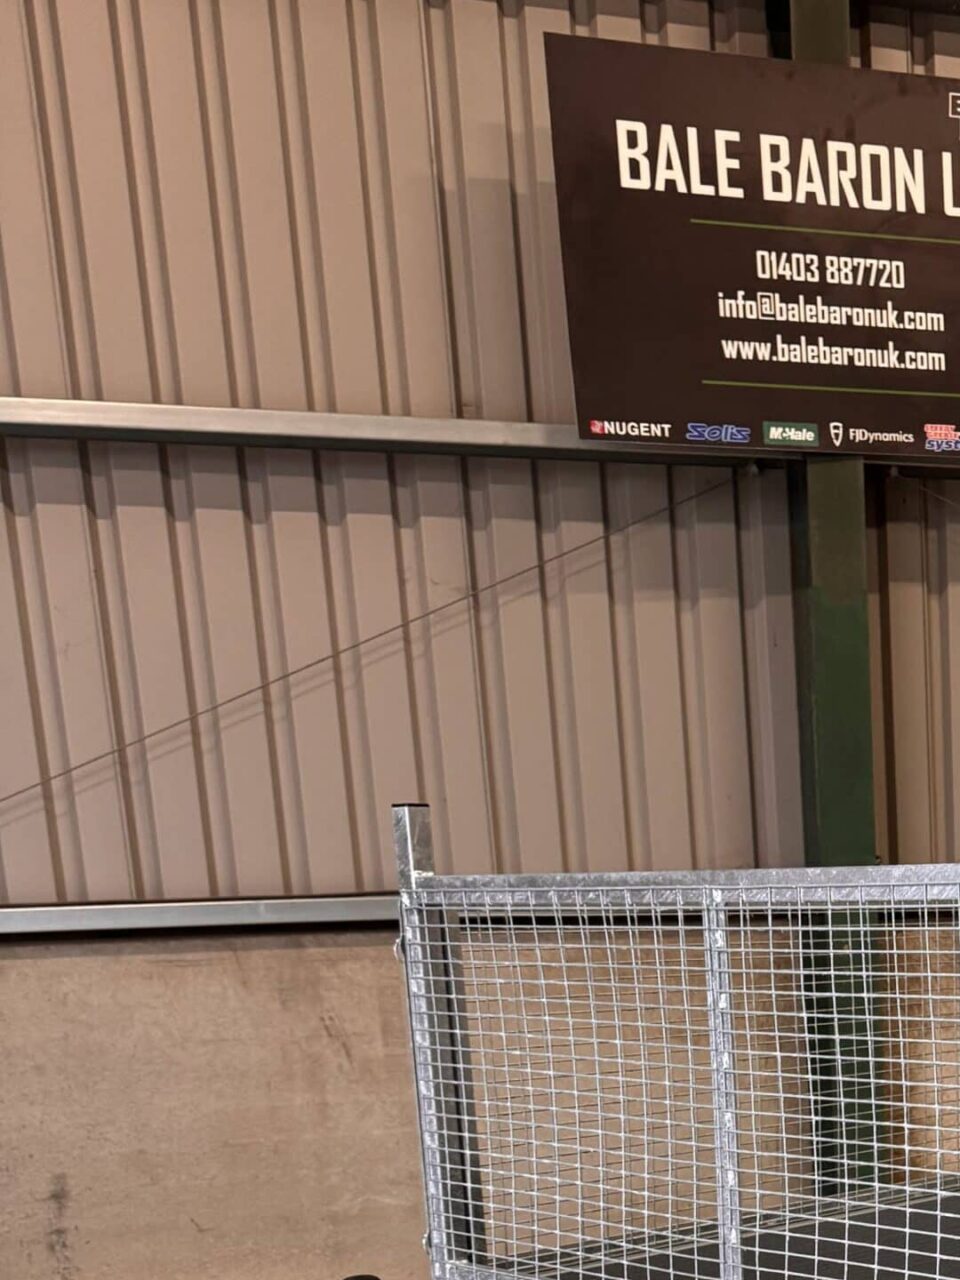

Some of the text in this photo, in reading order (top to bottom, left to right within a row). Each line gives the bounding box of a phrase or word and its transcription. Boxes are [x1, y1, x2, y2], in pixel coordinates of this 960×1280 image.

[616, 119, 745, 199] BALE
[759, 133, 926, 214] BARON
[756, 250, 905, 289] 01403 887720
[718, 291, 945, 332] info@balebaronuk.com
[721, 334, 946, 371] www.balebaronuk.com
[604, 421, 672, 438] NUGENT
[849, 428, 915, 443] FJDynamics
